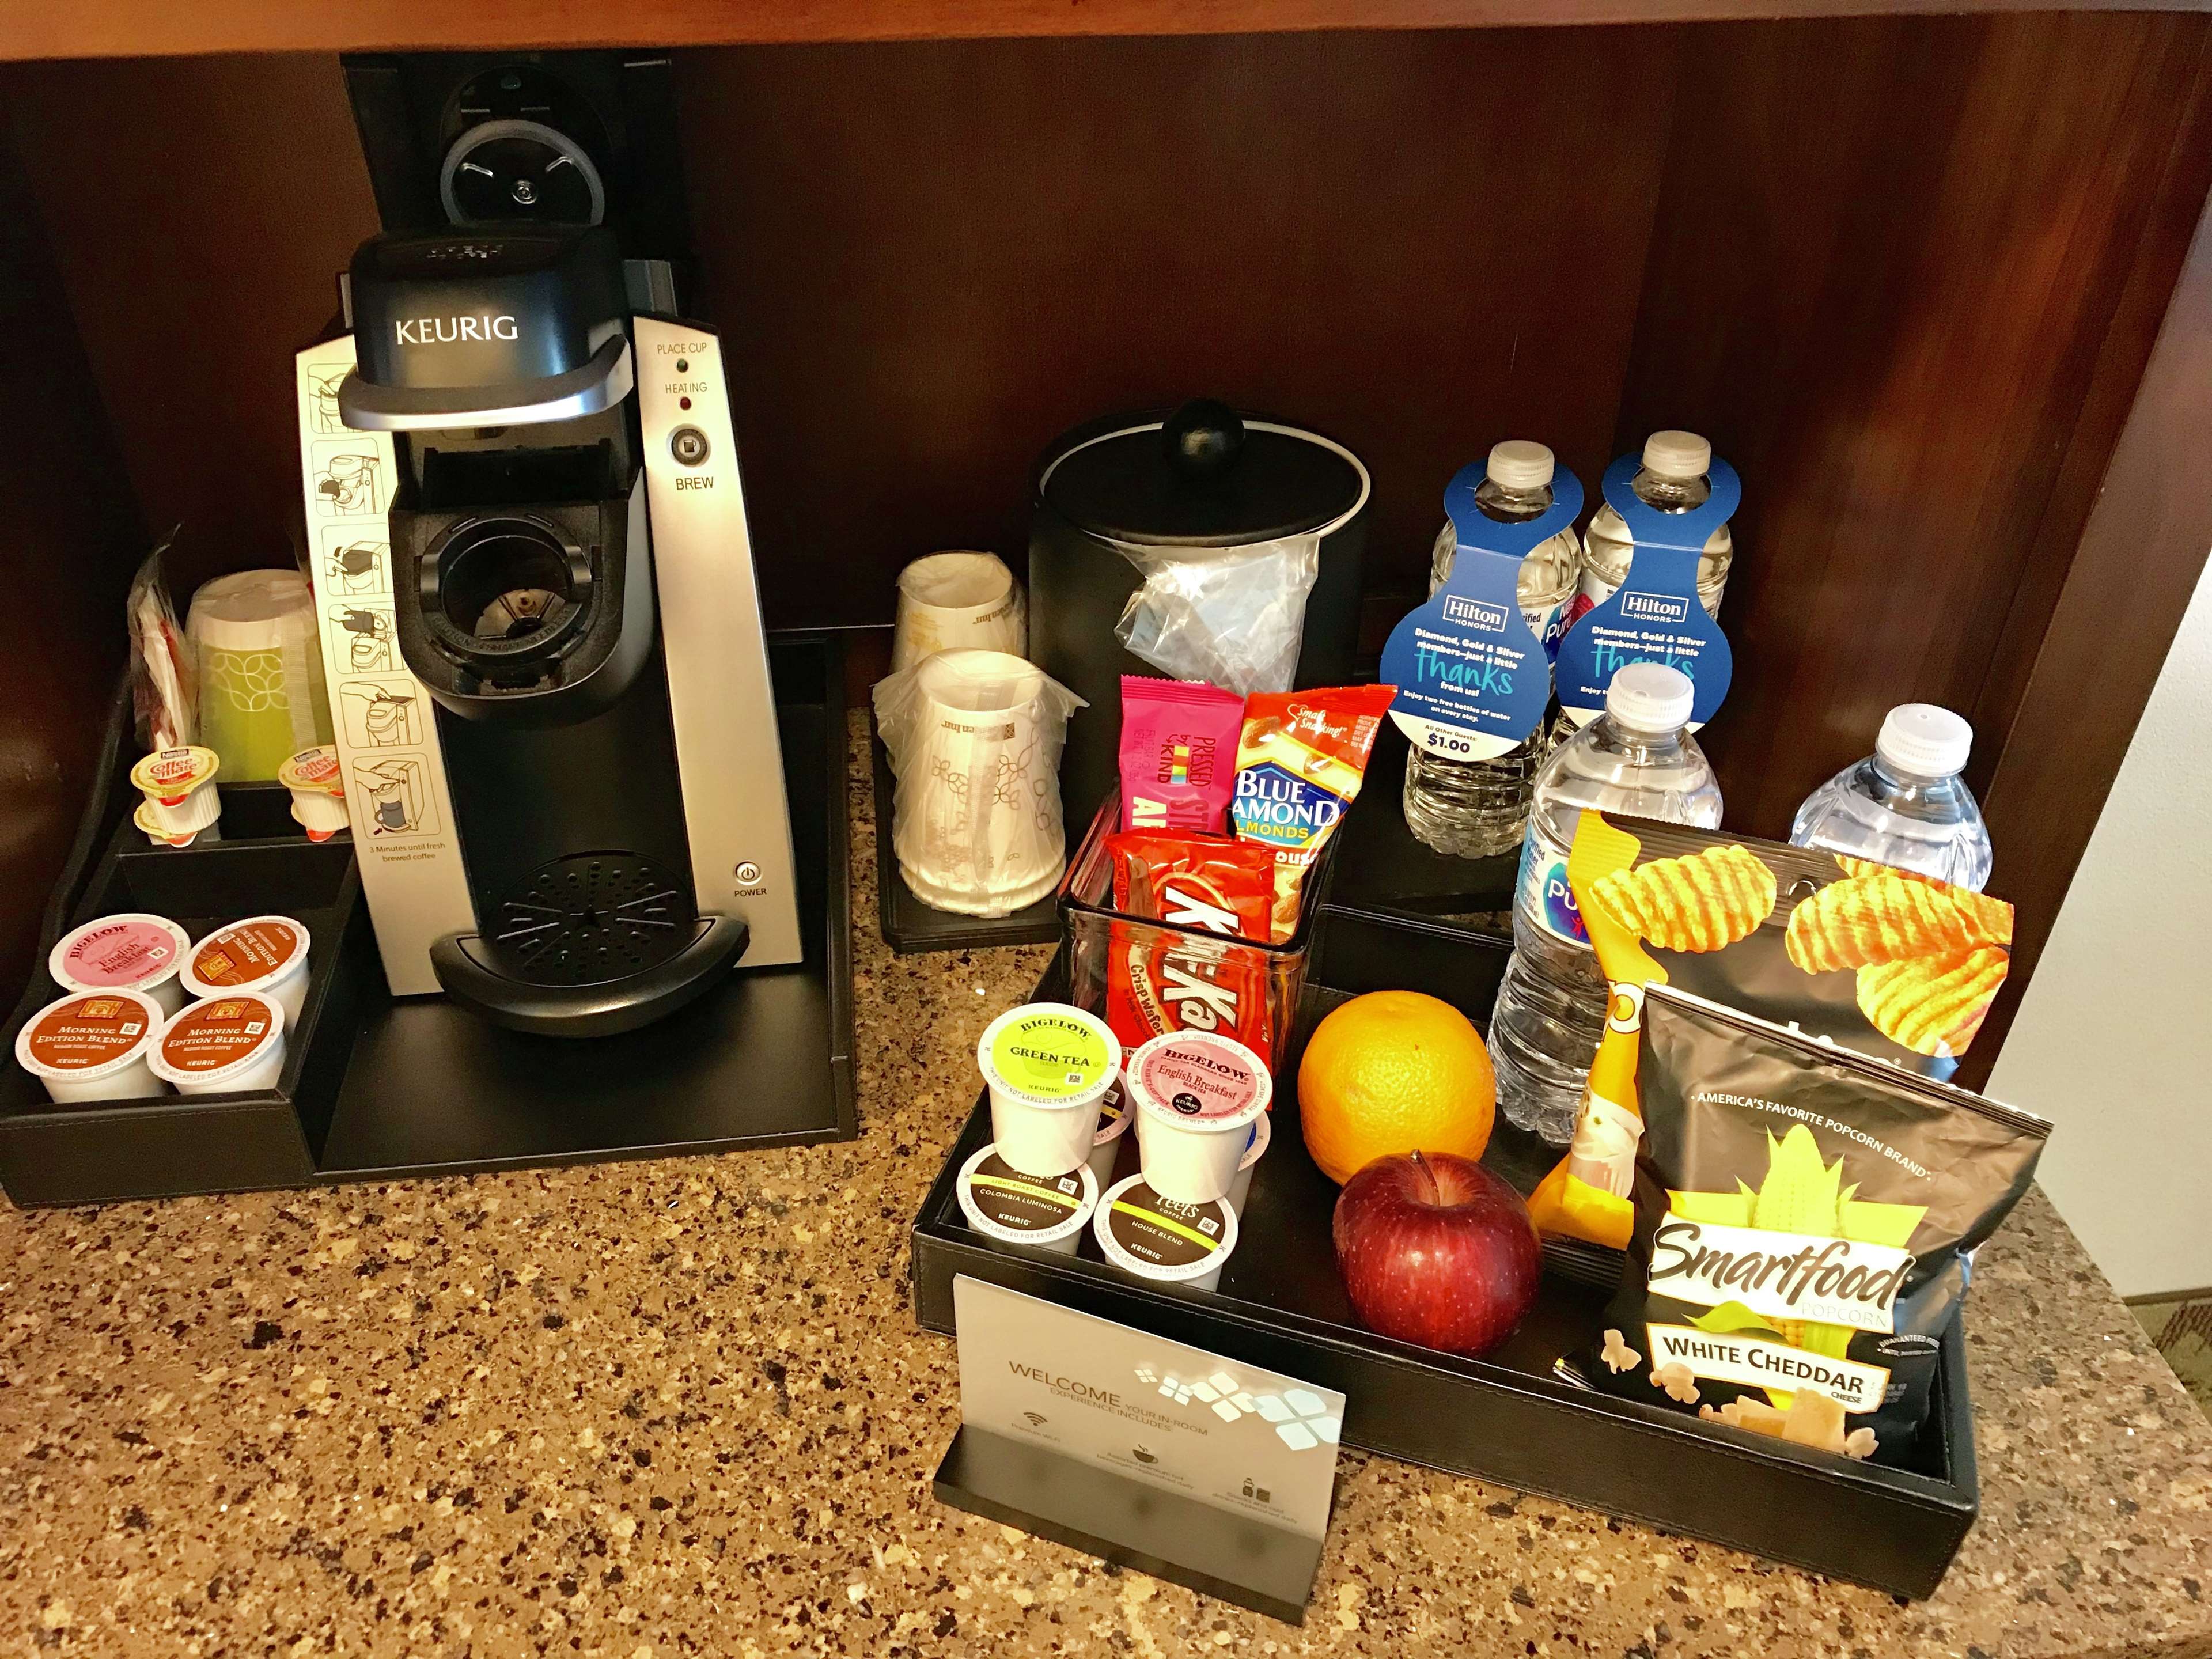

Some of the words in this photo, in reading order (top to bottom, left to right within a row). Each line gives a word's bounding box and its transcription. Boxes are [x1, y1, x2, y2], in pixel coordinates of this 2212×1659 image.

[396, 316, 518, 345] KEURIG
[657, 344, 685, 354] PLACE
[688, 343, 707, 353] CUP
[665, 382, 707, 393] HEATING
[676, 476, 714, 490] BREW
[1449, 600, 1501, 624] Hilton
[1627, 597, 1681, 616] Hilton
[1455, 618, 1491, 631] HONORS
[1633, 613, 1672, 623] HONORS
[1415, 628, 1460, 646] Diamond,
[1462, 639, 1485, 651] Gold
[1496, 646, 1525, 660] Silver
[1591, 626, 1639, 640] Diamond,
[1641, 632, 1664, 641] Gold
[1677, 636, 1706, 647] Silver
[1675, 647, 1699, 657] little
[1414, 647, 1513, 696] thanks
[1486, 657, 1493, 665] a
[1494, 657, 1518, 669] little
[1440, 681, 1463, 694] from
[1465, 688, 1480, 697] us!
[1580, 687, 1603, 695] Enjoy
[1297, 707, 1327, 719] Smat
[1403, 690, 1423, 700] Enjoy
[1439, 698, 1453, 707] free
[1455, 700, 1480, 714] bottles
[1490, 711, 1511, 721] water
[1441, 707, 1461, 717] every
[1462, 713, 1479, 722] stay.
[1300, 718, 1343, 738] Snaking!
[1435, 726, 1453, 736] Other
[1455, 731, 1477, 741] Guests:
[1177, 734, 1191, 746] by
[1427, 732, 1470, 753] $1.00
[150, 757, 194, 775] Coffee
[160, 763, 197, 778] mate
[294, 755, 330, 777] Coffee
[1157, 744, 1175, 783] KIND
[1189, 737, 1216, 787] PRESSED
[1236, 770, 1305, 803] BLUE
[1233, 798, 1340, 827] AMOND
[734, 888, 767, 898] POWER
[69, 926, 128, 958] BIGELOW
[233, 937, 260, 963] MORNING
[98, 942, 140, 967] English
[101, 946, 153, 974] Breakfast
[255, 942, 278, 967] EDITION
[1130, 964, 1147, 997] Crisp
[58, 1026, 116, 1035] MORNING
[187, 1028, 241, 1036] MORNING
[1021, 1019, 1092, 1038] BIGELOW
[36, 1035, 85, 1044] EDITION
[87, 1035, 127, 1044] BLEND
[168, 1037, 213, 1047] EDITION
[214, 1036, 252, 1044] BLEND
[1010, 1047, 1058, 1063] GREEN
[1063, 1056, 1090, 1066] TEA
[1162, 1048, 1251, 1080] BIGELOW
[1028, 1084, 1061, 1093] KEURIG
[1070, 1090, 1091, 1102] RETAIL
[1091, 1081, 1104, 1093] SALE
[1158, 1064, 1192, 1083] English
[1194, 1075, 1237, 1100] Breakfast
[1183, 1082, 1197, 1092] BLACK
[1175, 1099, 1198, 1111] KEURIG
[1097, 1130, 1111, 1139] SALE
[1697, 1092, 1765, 1110] AMERICA'S
[1765, 1101, 1825, 1126] FAVORITE
[1825, 1119, 1884, 1152] POPCORN
[1883, 1146, 1928, 1179] BRAND
[1018, 1175, 1043, 1184] COFFEE
[980, 1188, 1021, 1202] COLOMBIA
[1022, 1198, 1062, 1214] LUMINOSA
[1012, 1183, 1033, 1192] ROAST
[1035, 1188, 1059, 1200] COFFEE
[998, 1213, 1030, 1226] KEURIG
[1159, 1207, 1184, 1220] COFFEE
[979, 1217, 991, 1226] NOT
[990, 1225, 1018, 1238] LABELED
[1036, 1229, 1058, 1238] RETAIL
[1059, 1221, 1073, 1232] SALE
[1131, 1221, 1157, 1235] HOUSE
[1158, 1232, 1183, 1246] BLEND
[1130, 1243, 1162, 1260] KEURIG
[1190, 1261, 1205, 1271] SALE
[1648, 1222, 1916, 1311] Smartfood
[1801, 1302, 1887, 1328] POPCORN
[1879, 1335, 1926, 1347] GUARANTEED
[1662, 1336, 1741, 1365] WHITE
[1747, 1348, 1864, 1394] CHEDDAR
[1009, 1360, 1121, 1407] WELCOME
[1125, 1403, 1157, 1419] YOUR
[1158, 1413, 1208, 1437] IN-ROOM
[1050, 1387, 1116, 1414] EXPERIENCE
[1831, 1391, 1862, 1404] CHEESE
